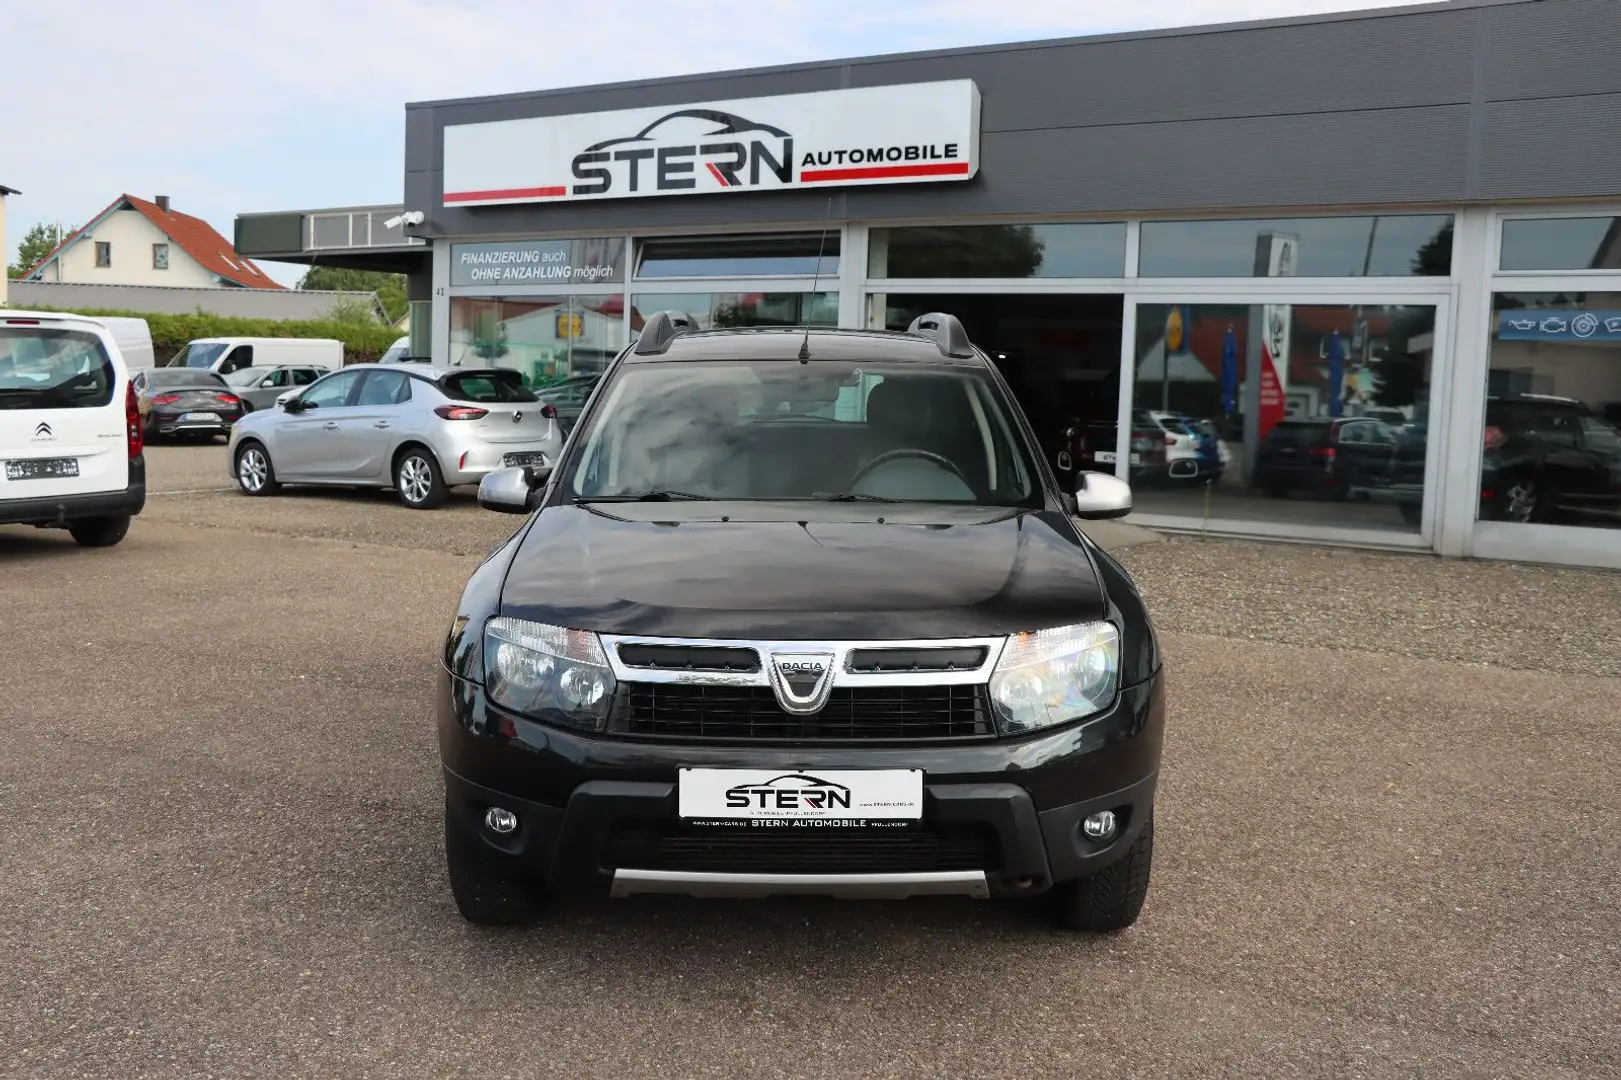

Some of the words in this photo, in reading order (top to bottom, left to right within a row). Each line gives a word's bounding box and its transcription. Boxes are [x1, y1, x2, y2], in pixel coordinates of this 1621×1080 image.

[571, 138, 794, 195] STERN
[802, 144, 958, 166] AUTOMOBILE
[461, 250, 540, 265] FINANZIERUNG
[542, 249, 567, 262] auch
[471, 267, 501, 280] OHNE
[503, 265, 572, 279] ANZAHLUNG
[573, 264, 613, 281] möglich
[782, 662, 823, 670] DACIA
[725, 789, 851, 808] STERN
[751, 819, 789, 827] STERN
[792, 819, 867, 827] AUTOMOBILE
